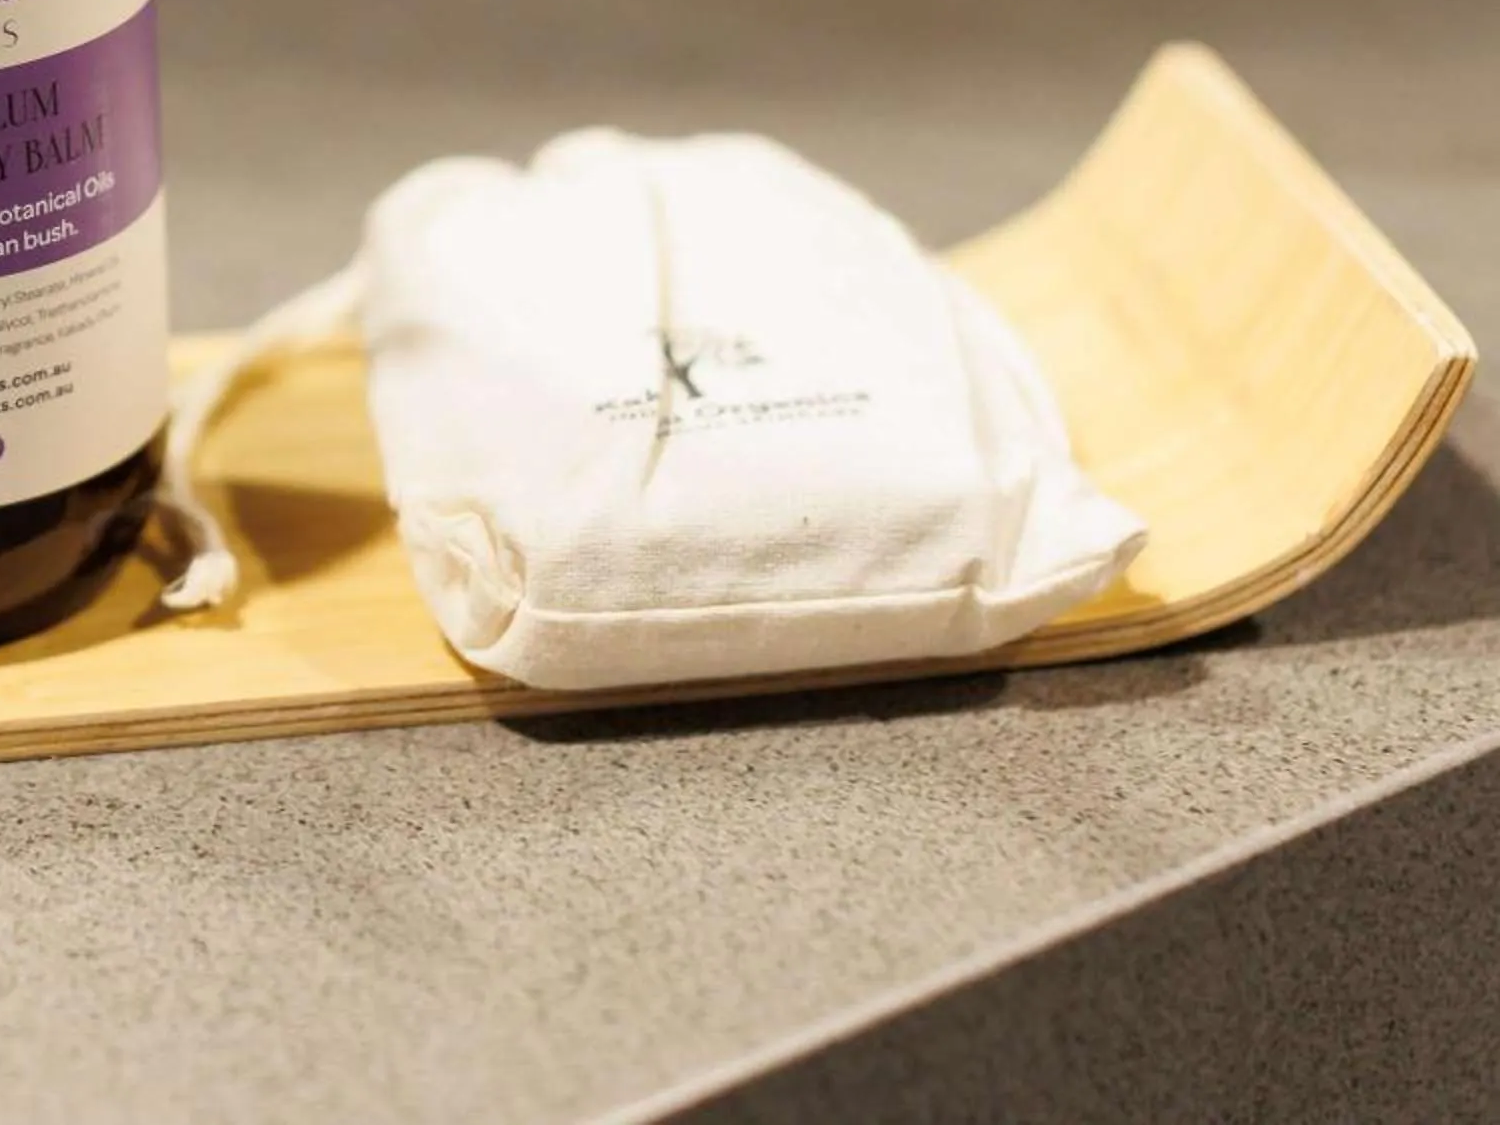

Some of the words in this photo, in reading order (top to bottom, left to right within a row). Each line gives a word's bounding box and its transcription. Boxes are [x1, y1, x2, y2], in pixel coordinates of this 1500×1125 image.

[25, 113, 105, 174] BALM
[83, 171, 116, 199] Oils
[24, 219, 78, 253] bush.
